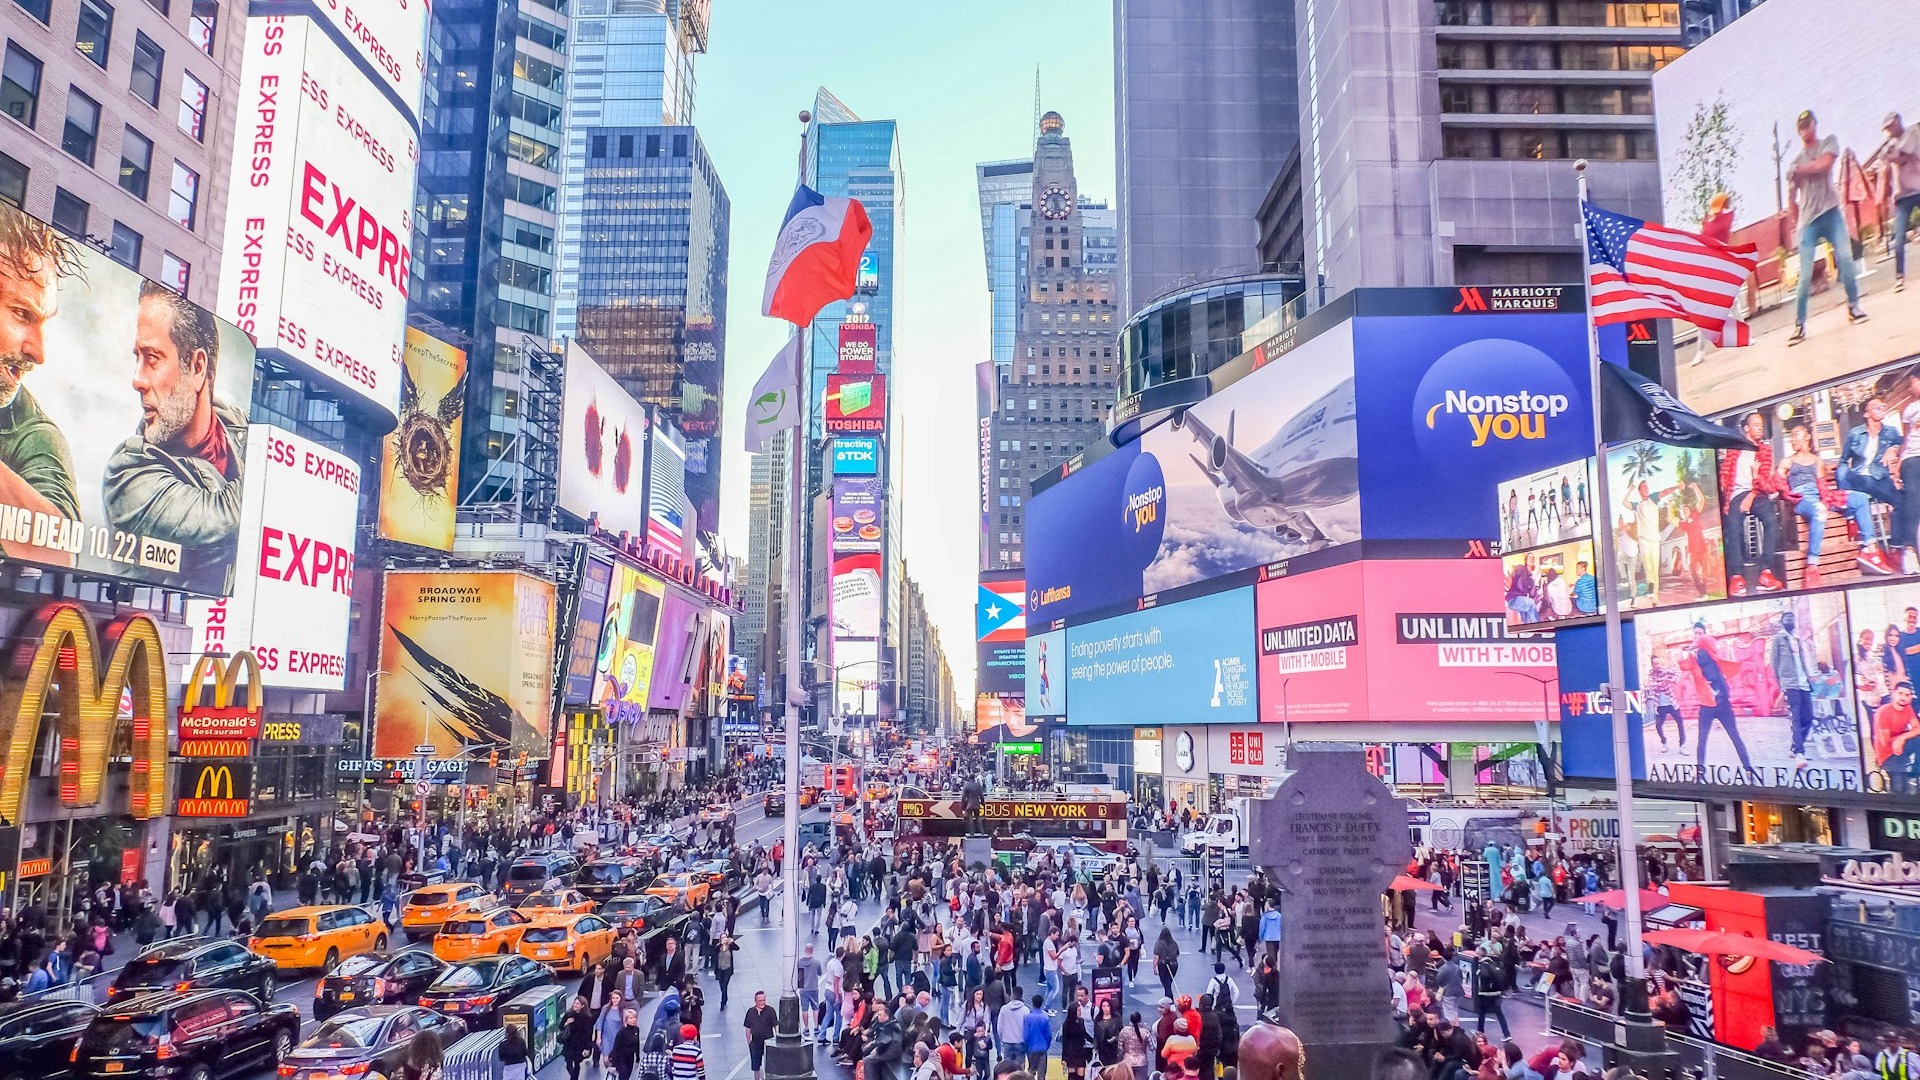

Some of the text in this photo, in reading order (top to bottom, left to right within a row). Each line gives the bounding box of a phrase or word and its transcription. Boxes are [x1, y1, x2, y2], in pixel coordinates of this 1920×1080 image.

[344, 5, 401, 82] EXPRESS
[250, 75, 280, 187] EXPRESS
[336, 104, 395, 174] EXPRESS
[300, 159, 411, 300] EXPRE
[860, 256, 870, 271] 2
[323, 252, 383, 311] EXPRESS
[1493, 287, 1563, 297] MARRIOTT
[1493, 299, 1556, 309] MARQUIS
[1267, 325, 1298, 349] MARRIOTT
[1267, 338, 1294, 360] MARQUIS
[315, 336, 376, 390] EXPRESS
[1116, 393, 1142, 411] MARRIOTT
[1445, 389, 1568, 417] Nonstop
[1116, 404, 1139, 421] MARQUIS
[827, 420, 884, 430] TOSHIBA
[1467, 413, 1546, 447] you
[845, 452, 873, 461] TDK
[304, 452, 358, 496] EXPRESS
[1129, 485, 1162, 512] Nonstop
[1135, 502, 1156, 534] you
[32, 511, 84, 554] DEAD
[90, 525, 137, 564] 10.22
[1268, 561, 1289, 571] MARRIOTT
[1268, 569, 1287, 579] MARQUIS
[1040, 585, 1071, 606] Lufthansa
[1071, 626, 1162, 658] Ending poverty starts with
[1264, 620, 1356, 651] UNLIMITED DATA
[288, 650, 344, 677] EXPRESS
[1222, 656, 1241, 666] ACUMEN
[1280, 649, 1345, 670] WITH T-MOBILE
[1443, 647, 1489, 663] WITH
[1071, 651, 1175, 682] seeing the power of people.
[181, 716, 257, 727] McDonald's
[262, 723, 301, 740] PRESS
[1249, 736, 1261, 748] UNI
[1249, 750, 1262, 763] QLO
[338, 760, 468, 773] GIFTS LUGAGE
[1649, 762, 1766, 787] AMERICAN
[1773, 766, 1858, 792] EAGLE
[1015, 804, 1087, 817] NEW YORK
[1295, 812, 1374, 821] LIEUTENANT COLONEL
[234, 829, 257, 839] EXPRESS
[268, 825, 289, 834] EXPRESS
[1290, 822, 1382, 833] FRANCIS DUFFY
[1569, 818, 1620, 838] PROUD
[1295, 835, 1309, 843] MAY
[1571, 839, 1583, 850] TO
[1302, 848, 1370, 856] CATHOLIC PRIEST
[1319, 867, 1355, 875] CHAPLAIN
[1331, 908, 1341, 916] OF
[1303, 923, 1318, 931] GOD
[1322, 923, 1338, 931] AND
